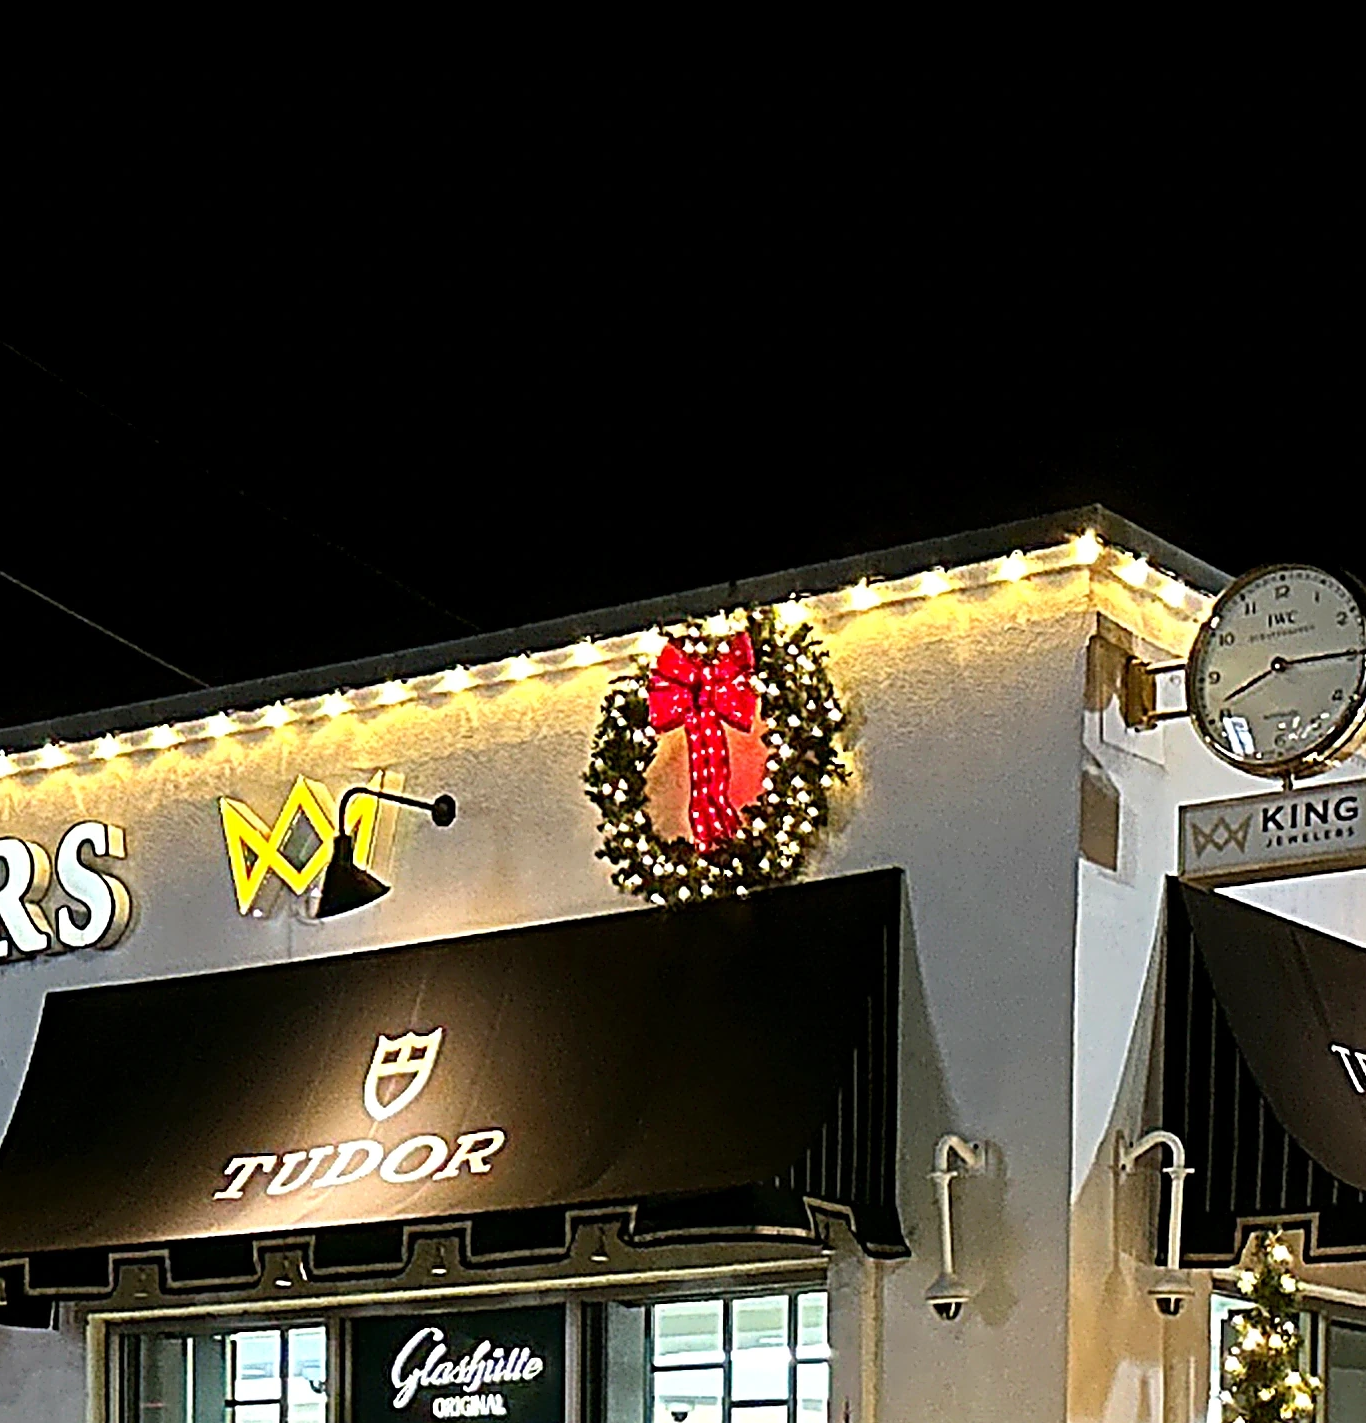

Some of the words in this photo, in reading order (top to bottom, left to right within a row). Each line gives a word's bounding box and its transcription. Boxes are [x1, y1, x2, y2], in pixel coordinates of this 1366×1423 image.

[1268, 609, 1299, 628] IWC
[1218, 632, 1235, 646] 10
[1208, 671, 1221, 685] 9
[1262, 796, 1359, 833] KING
[1266, 826, 1355, 848] JEWELERS
[212, 1129, 507, 1201] TUDOR
[390, 1326, 544, 1410] Glashütte
[432, 1393, 508, 1419] ORIGINAL
